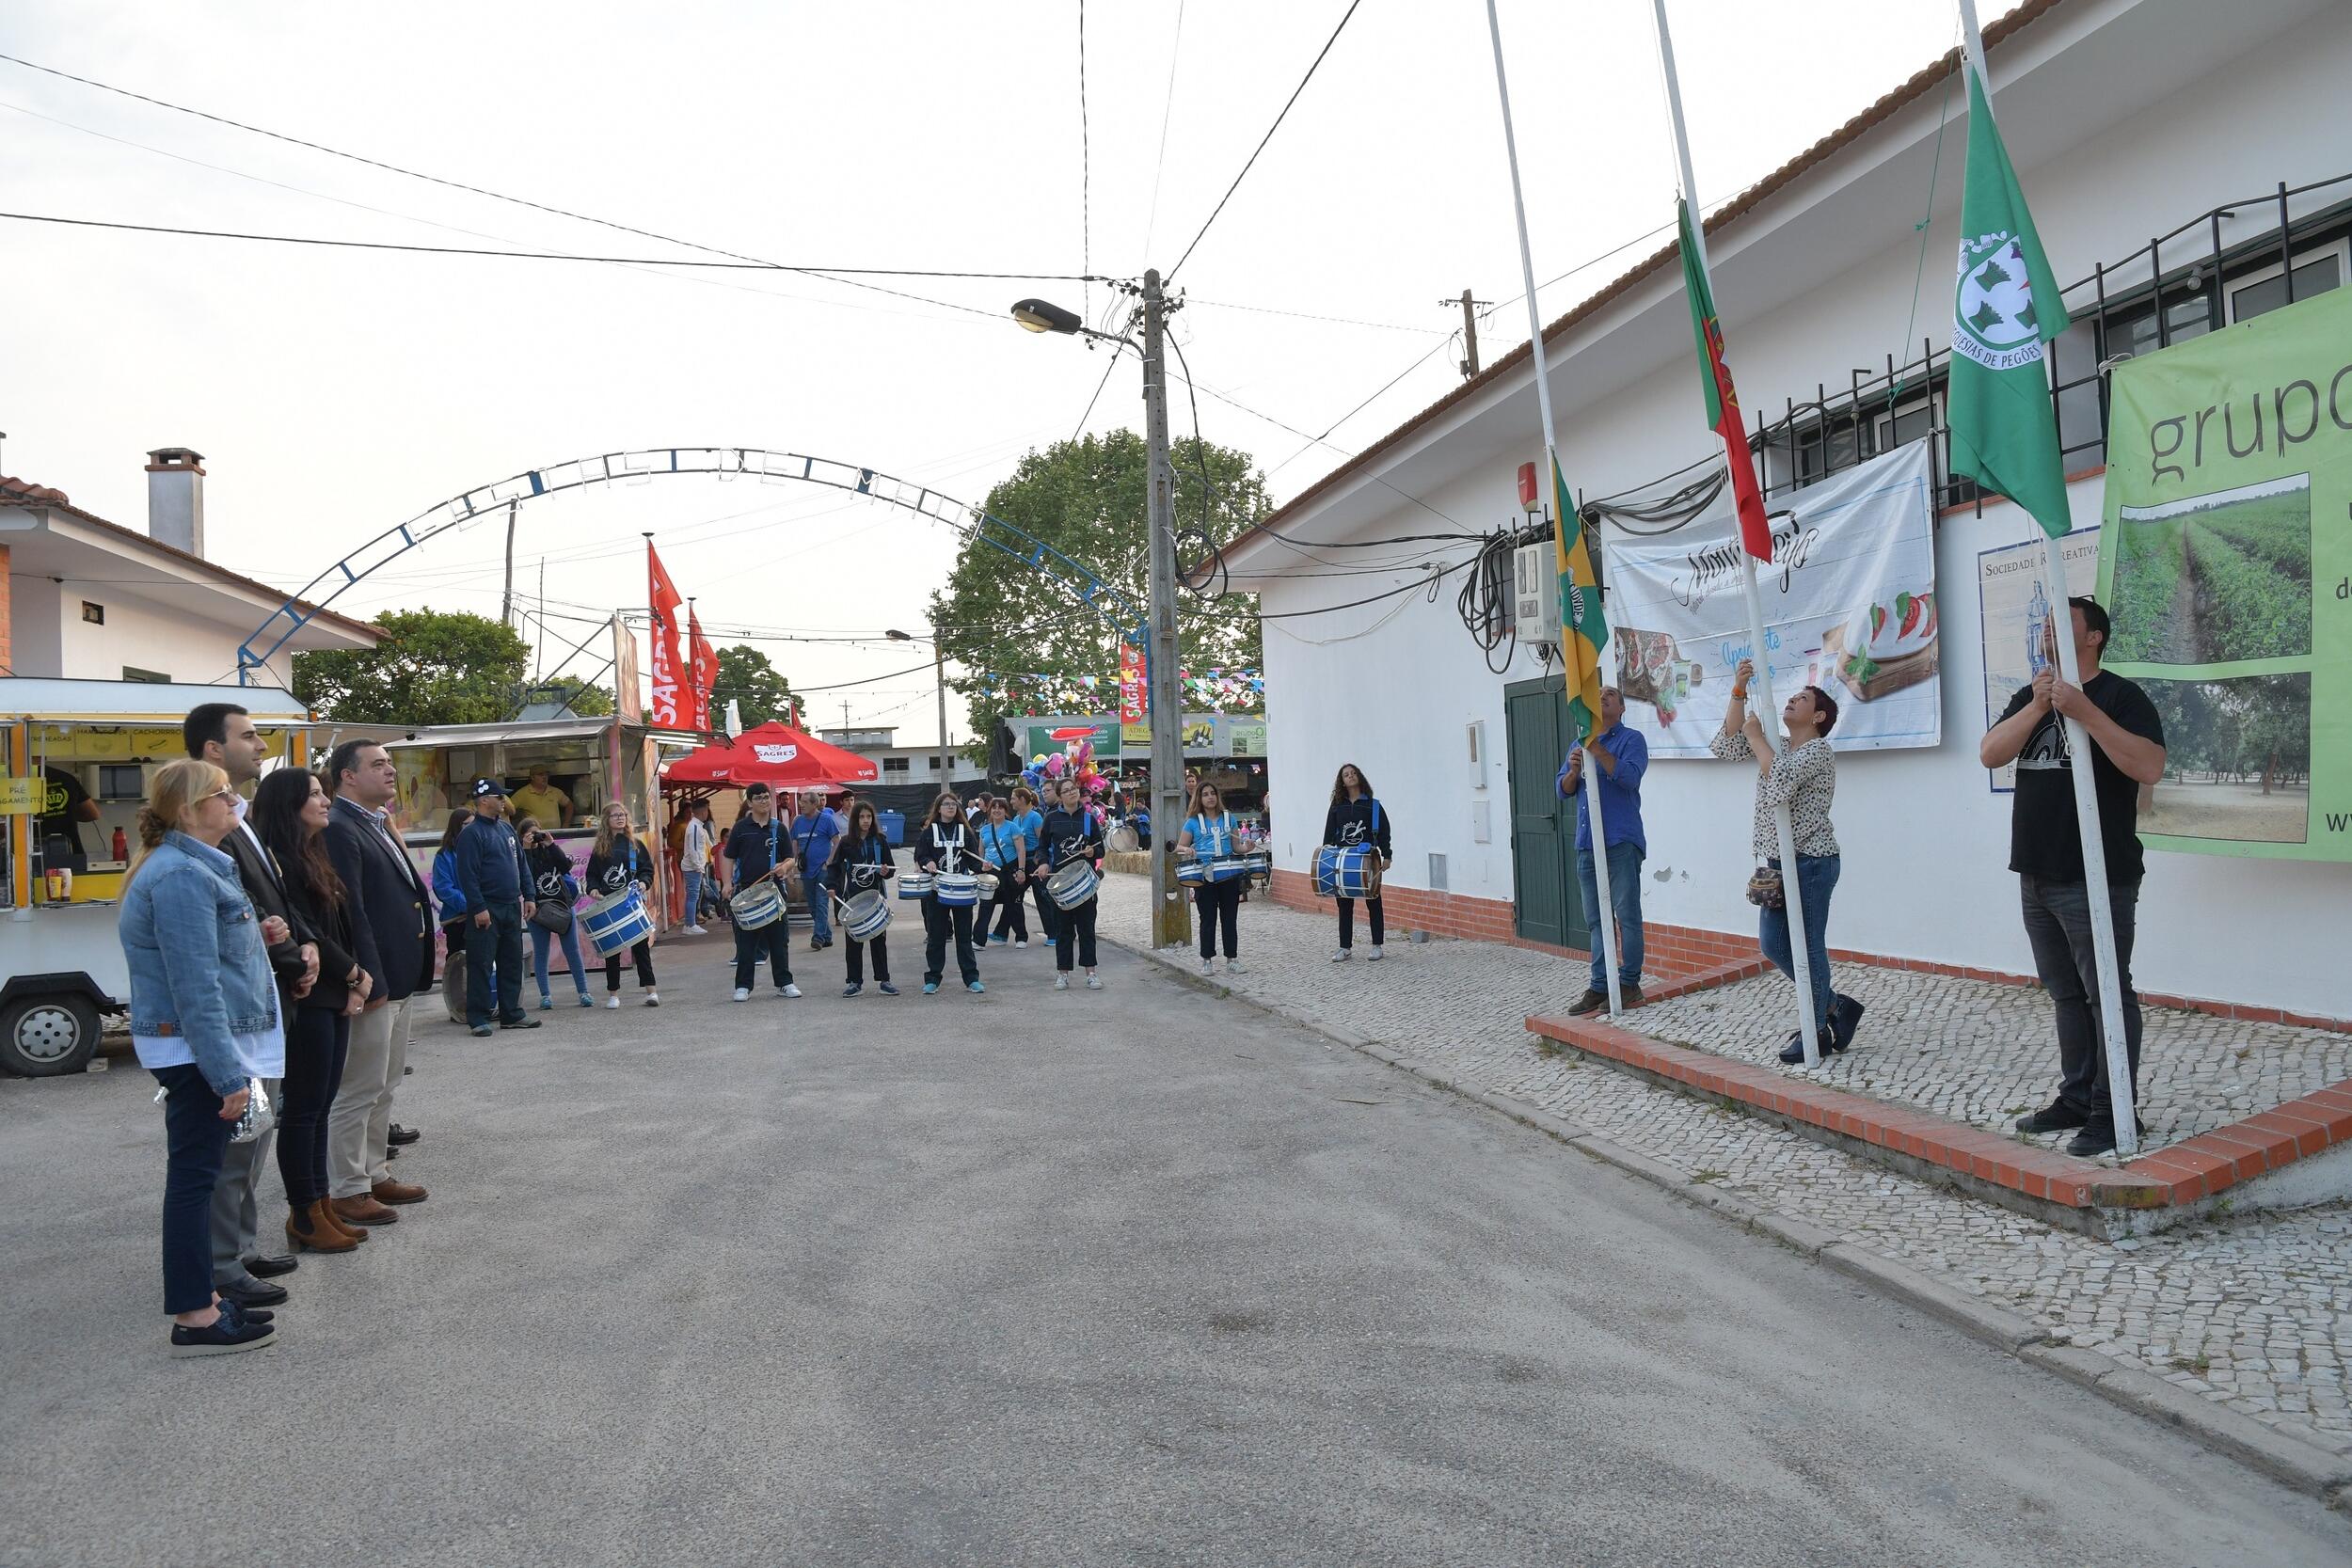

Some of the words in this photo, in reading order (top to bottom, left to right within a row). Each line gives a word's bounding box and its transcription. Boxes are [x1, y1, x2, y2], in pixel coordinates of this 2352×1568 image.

[1952, 330, 1983, 358] GUESIAS
[1983, 352, 1998, 367] DE
[2001, 344, 2041, 368] PEGÕES
[2040, 544, 2099, 565] RREATIVA
[9, 784, 26, 794] PRÉ
